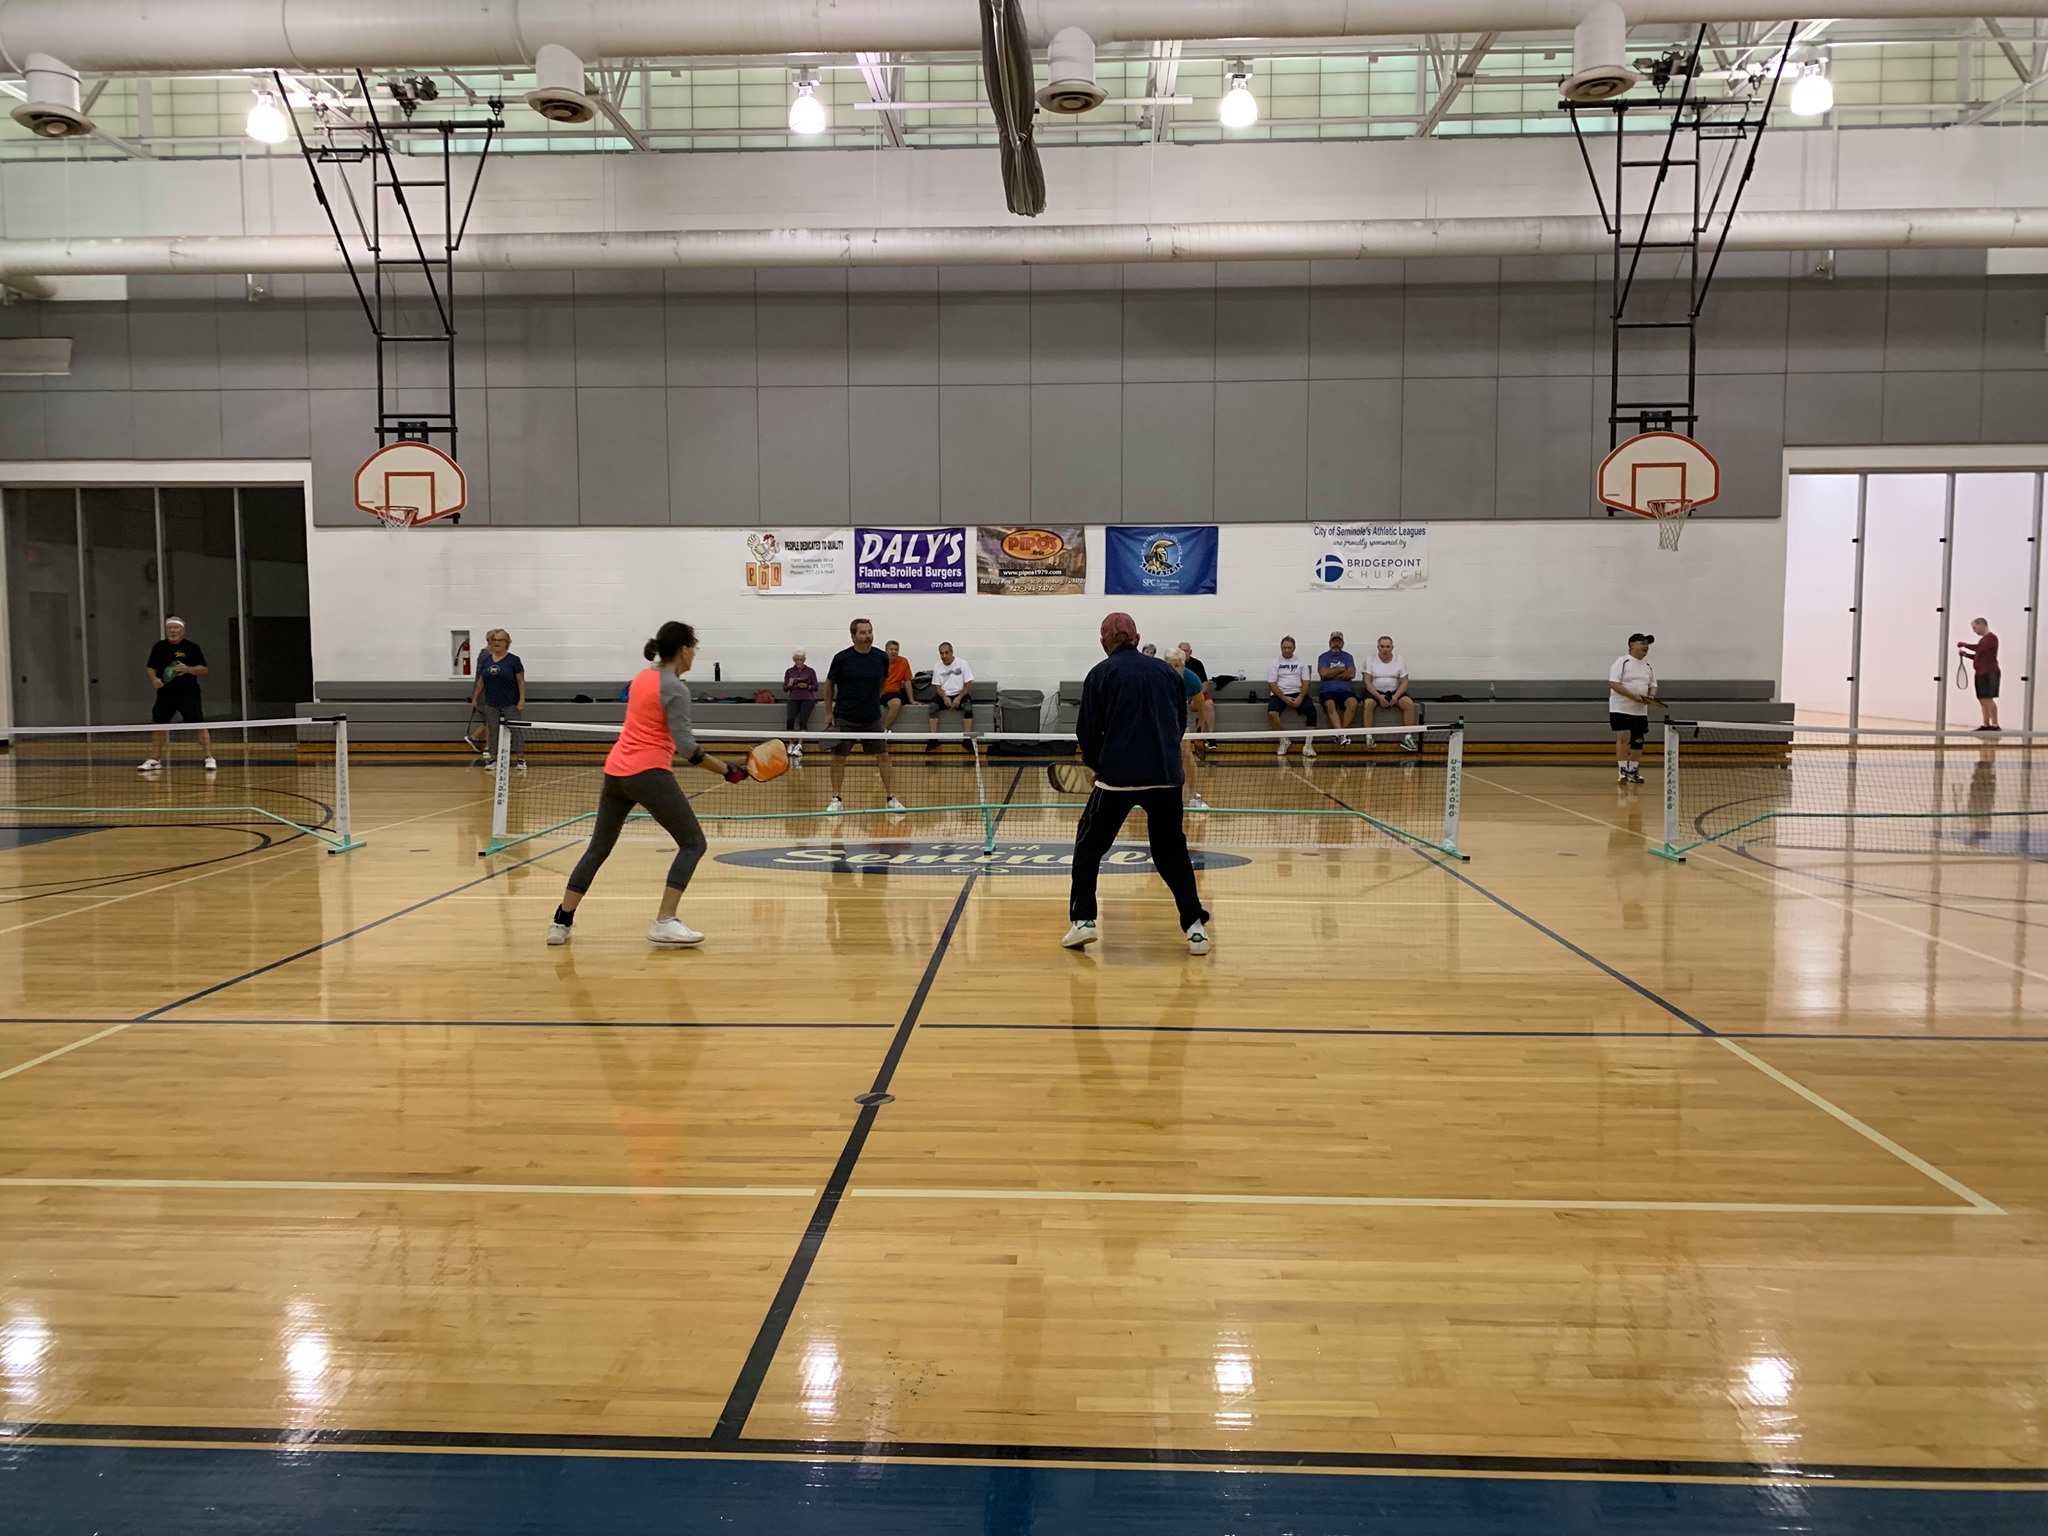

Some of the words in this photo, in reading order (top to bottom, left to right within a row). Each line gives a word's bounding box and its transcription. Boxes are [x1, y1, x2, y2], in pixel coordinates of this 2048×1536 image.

[1314, 526, 1326, 538] City
[1328, 526, 1335, 536] of
[1336, 526, 1371, 536] Seminole's
[1372, 526, 1397, 536] Athletic
[1398, 526, 1426, 538] Leagues
[785, 541, 799, 550] PEOPLE
[800, 541, 821, 550] DEDICATED
[821, 541, 827, 550] TO
[827, 540, 844, 550] QUALITY
[1343, 538, 1367, 549] proudly
[1369, 539, 1398, 547] sponsored
[1398, 539, 1407, 549] by
[858, 533, 963, 566] DALY'S
[1347, 559, 1422, 567] BRIDGEPOINT
[859, 566, 923, 577] Flame-Broiled
[925, 567, 962, 580] Burgers
[1003, 569, 1062, 577] www.pipos1979.com
[1347, 570, 1422, 579] CHURCH
[1142, 579, 1156, 587] SPC
[774, 849, 1195, 865] Seminl
